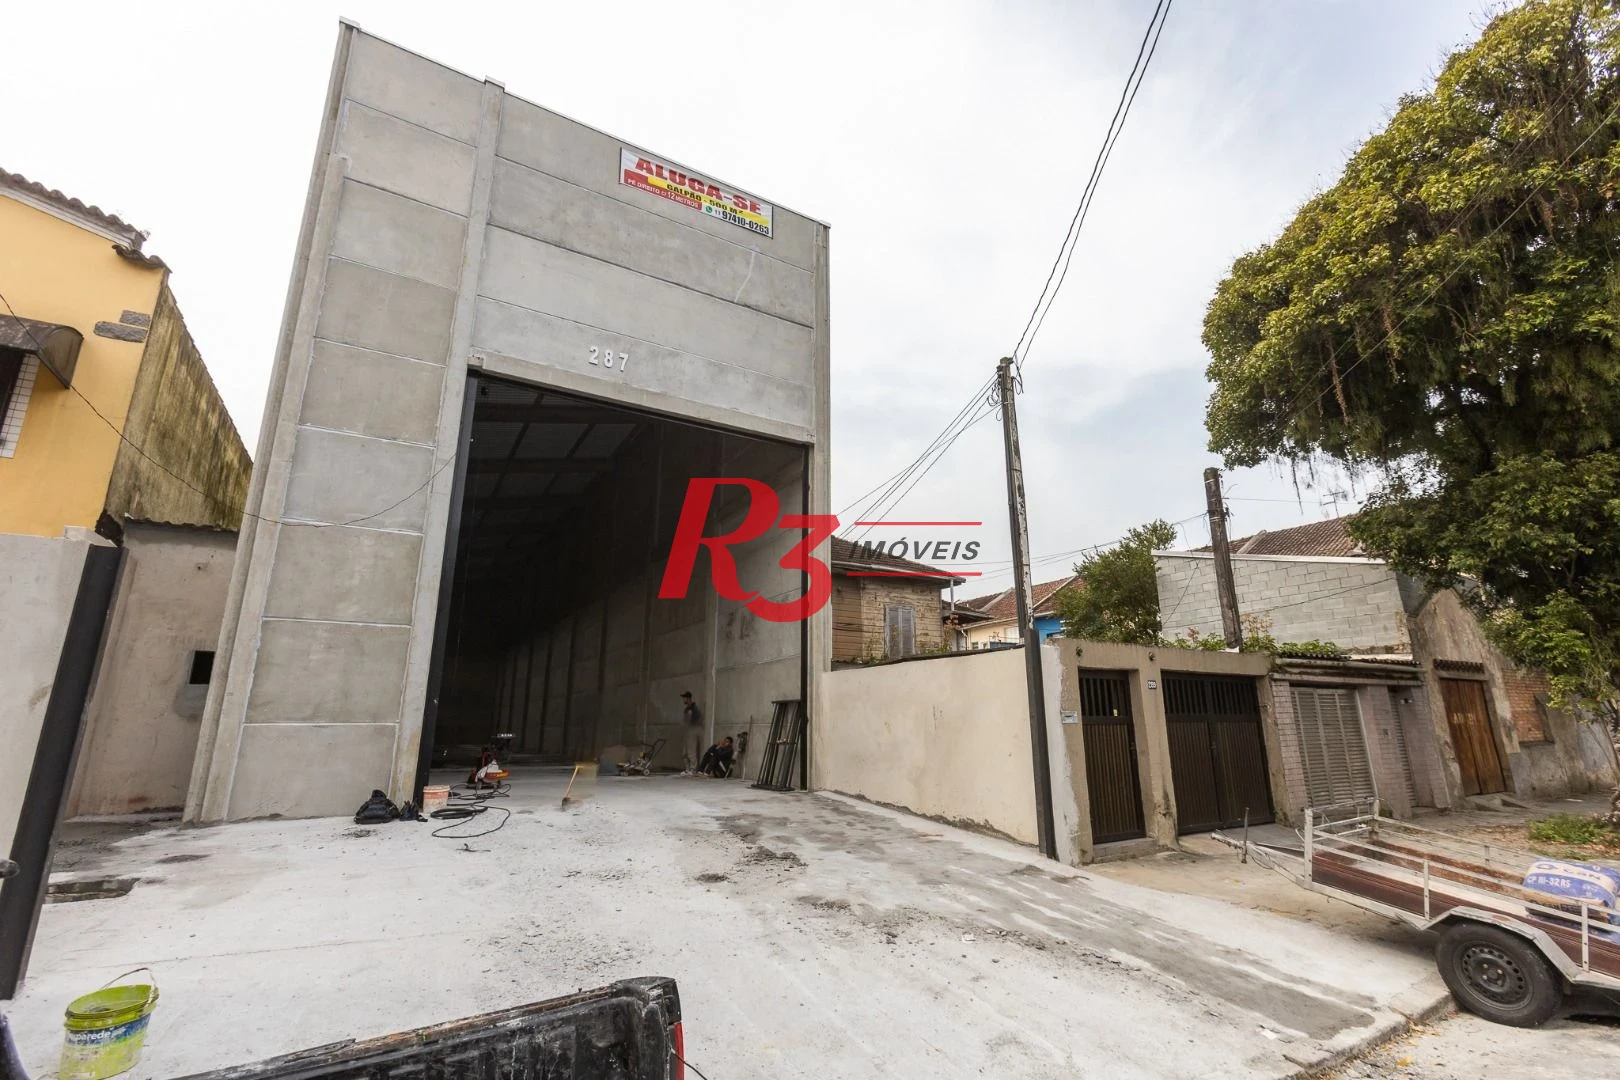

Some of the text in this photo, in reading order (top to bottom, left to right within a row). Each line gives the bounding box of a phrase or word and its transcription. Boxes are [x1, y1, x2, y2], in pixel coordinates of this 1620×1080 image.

[635, 157, 761, 216] ALUGA-SE
[637, 182, 660, 194] DIREITO
[667, 191, 675, 201] 12
[676, 195, 699, 208] METROS
[667, 183, 702, 202] GALPÃO
[709, 200, 728, 210] 500
[722, 210, 770, 235] 97410-0263
[588, 346, 629, 372] 287
